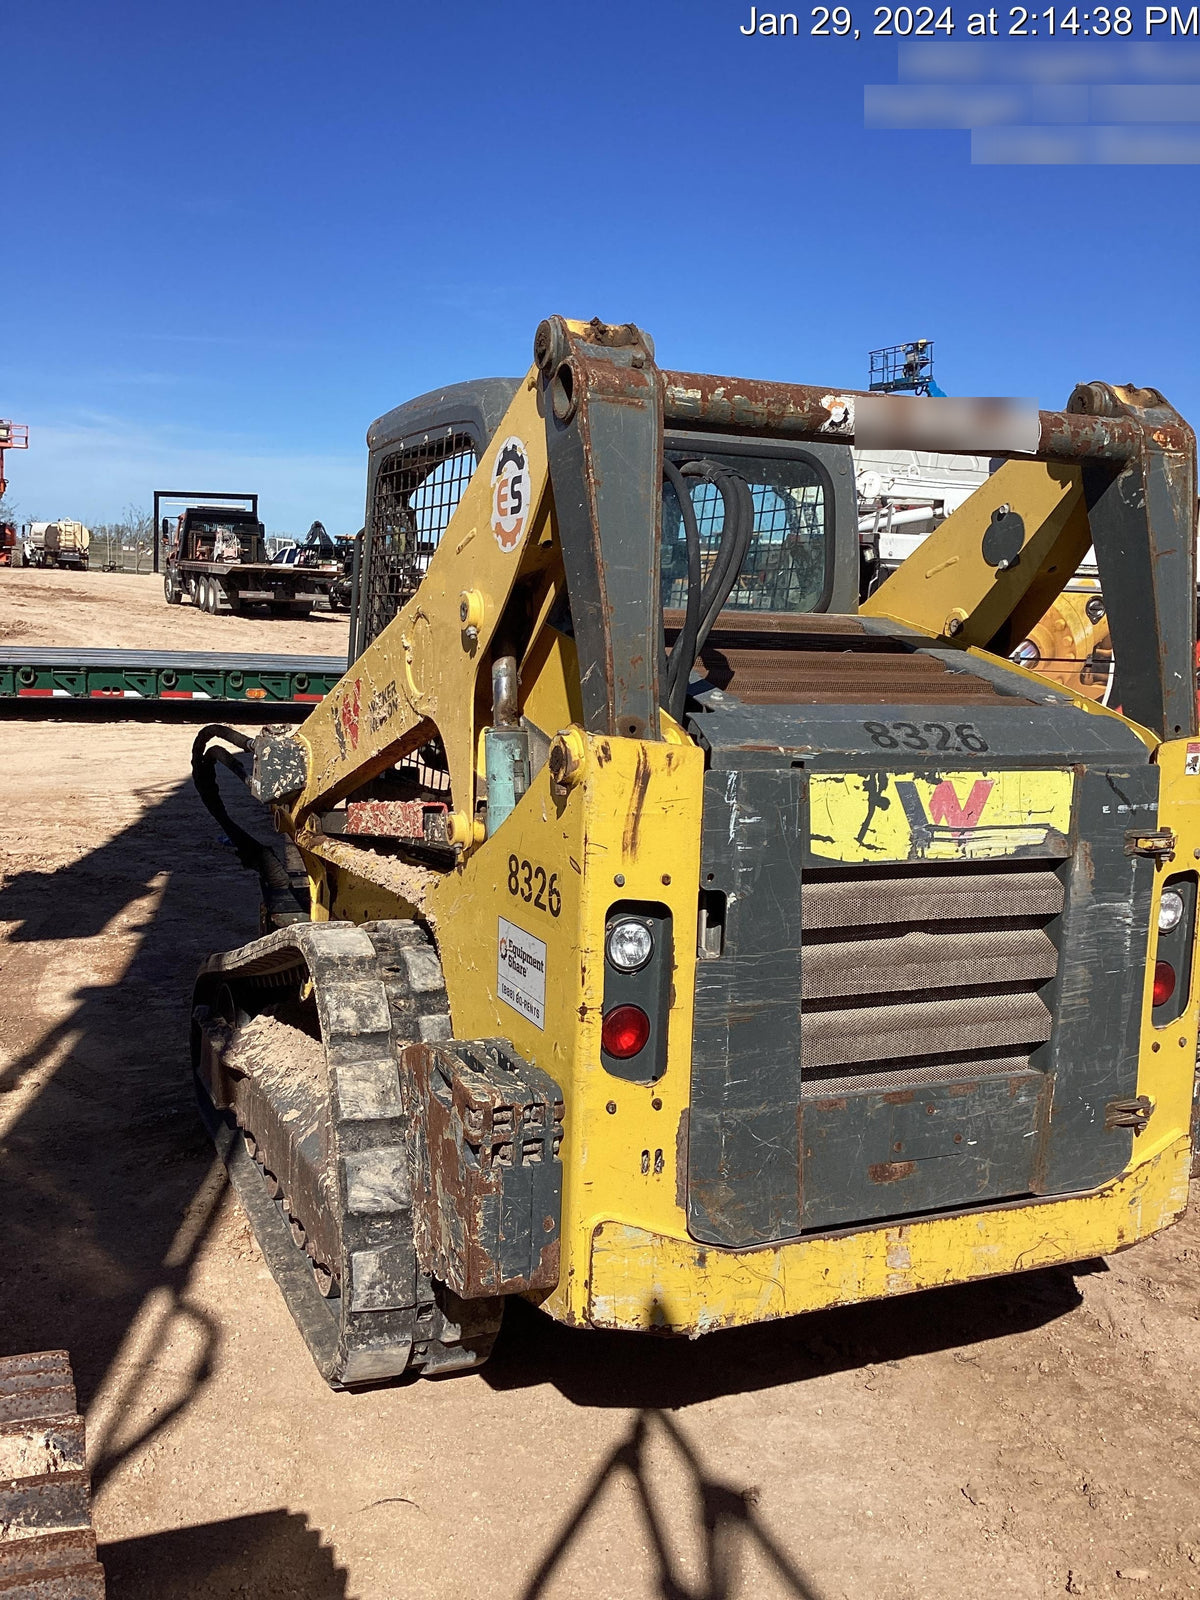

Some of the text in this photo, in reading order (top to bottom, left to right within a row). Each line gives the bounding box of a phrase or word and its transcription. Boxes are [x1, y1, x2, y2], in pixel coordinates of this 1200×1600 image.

[497, 474, 523, 517] ES
[863, 721, 989, 752] 8326
[508, 853, 561, 918] 8326
[508, 939, 544, 973] Equipment
[508, 956, 527, 977] Share
